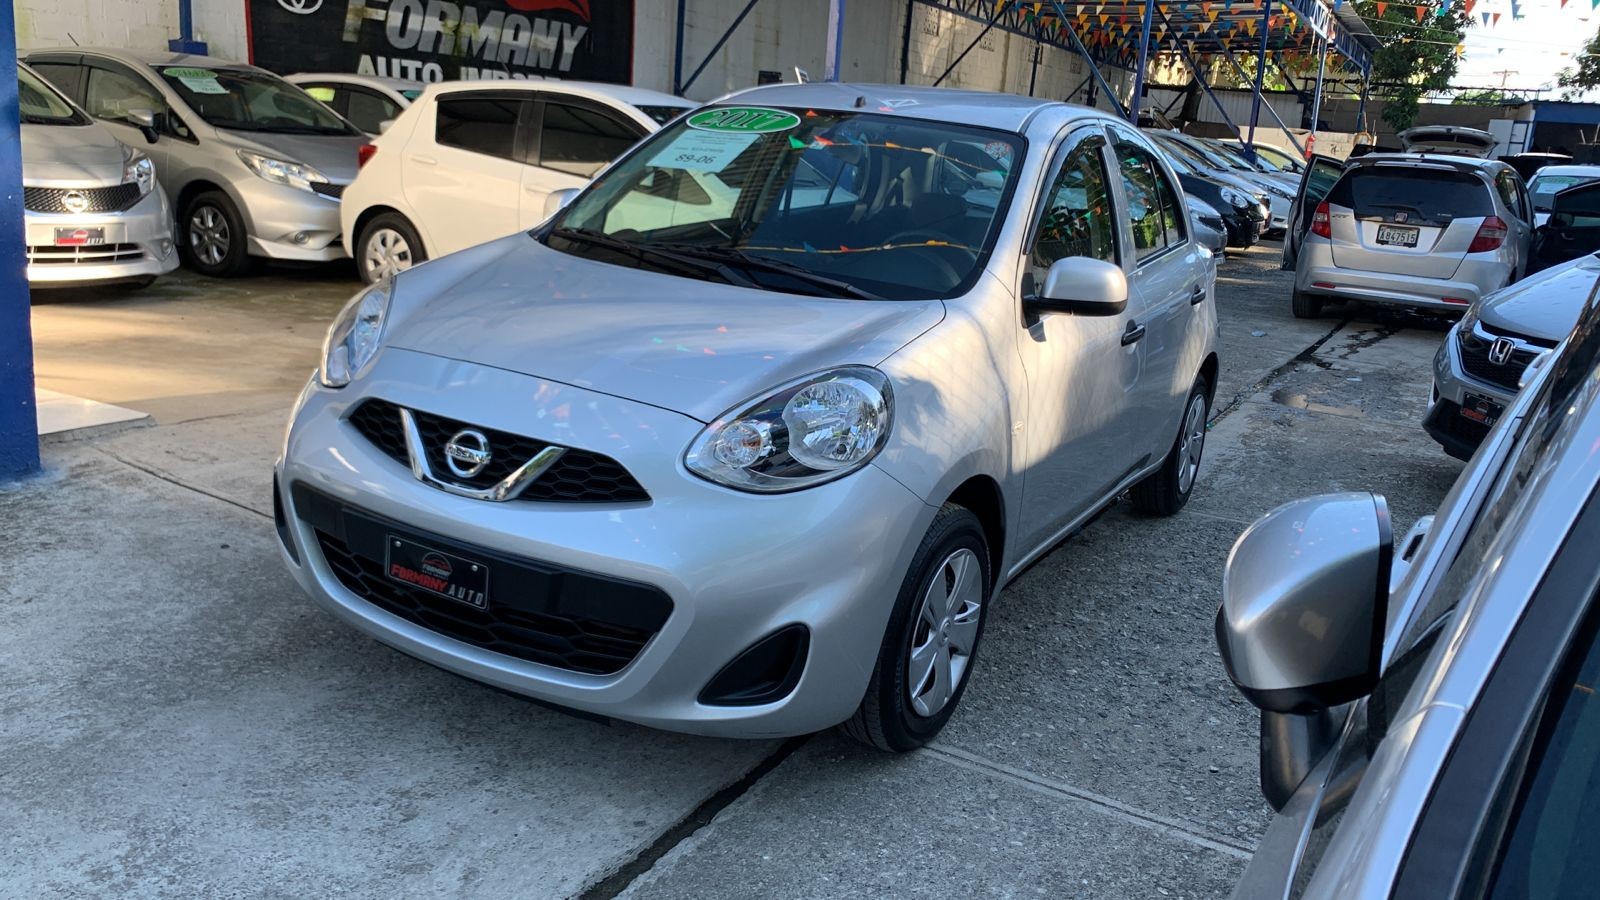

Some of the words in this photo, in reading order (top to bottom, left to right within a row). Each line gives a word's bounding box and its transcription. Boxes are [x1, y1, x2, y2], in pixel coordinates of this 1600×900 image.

[342, 0, 587, 72] FORMANY
[357, 54, 443, 82] AUTO
[697, 110, 790, 129] 2017
[391, 563, 448, 592] FORMANY
[448, 584, 484, 605] AUTO
